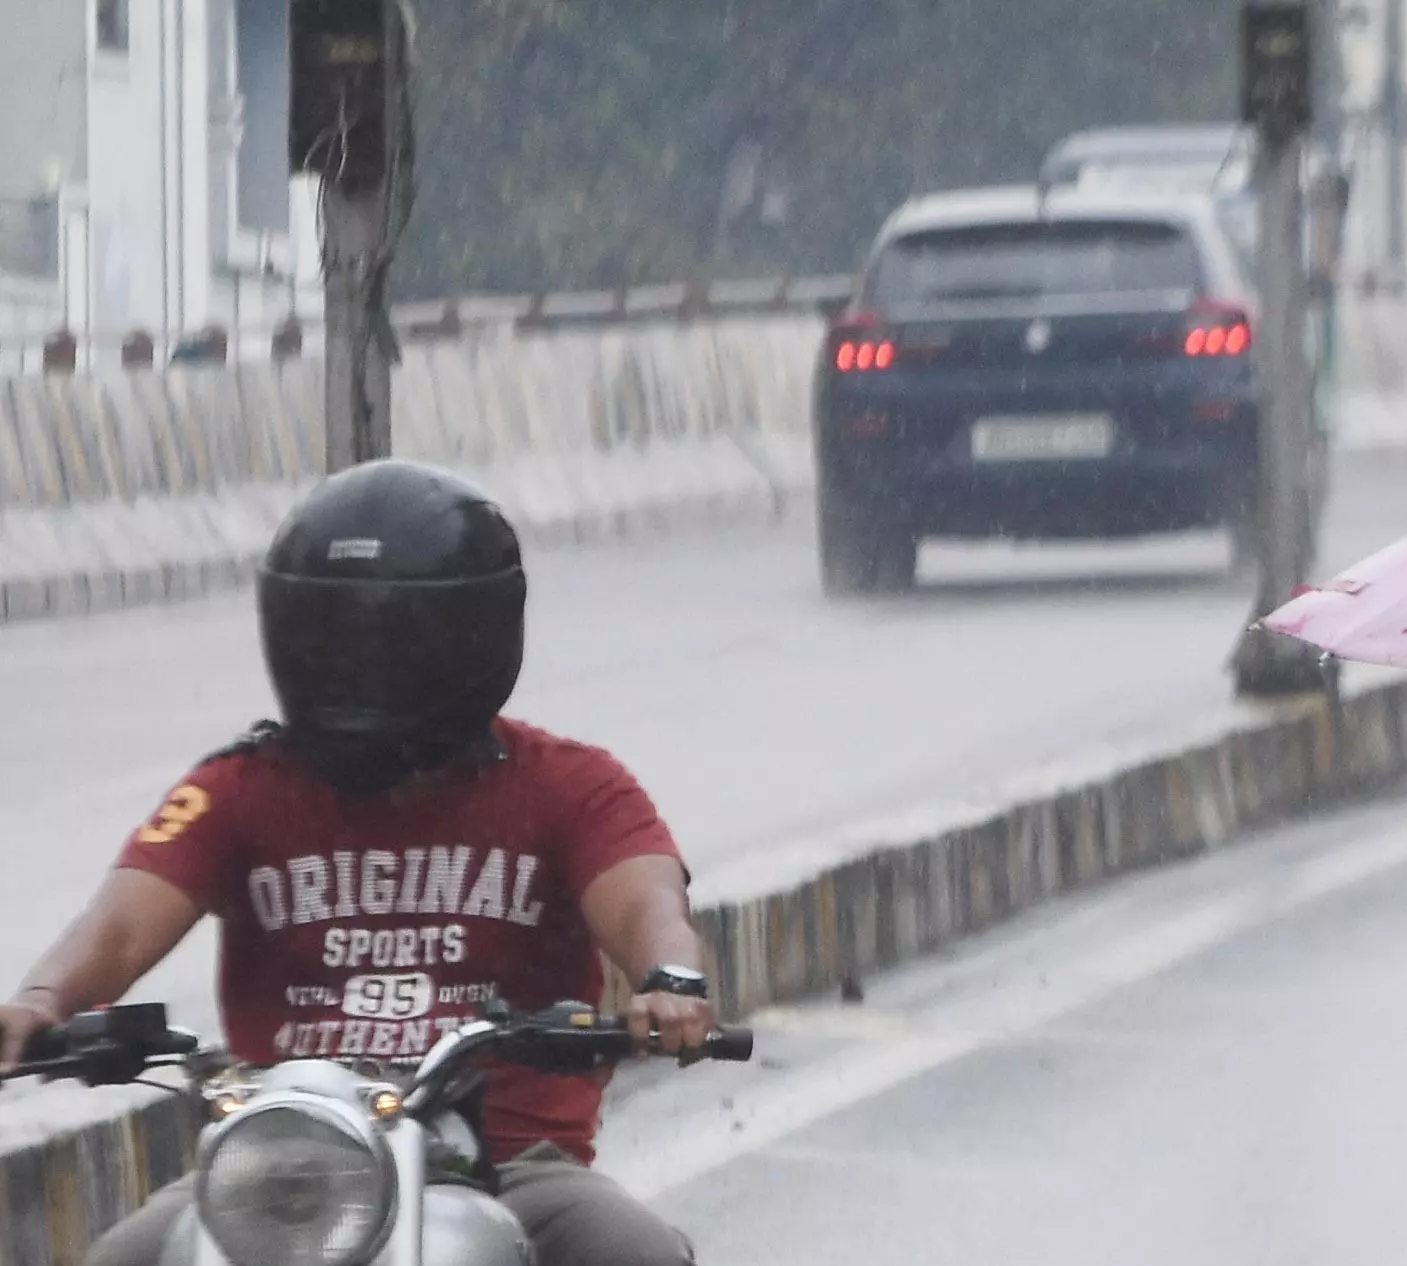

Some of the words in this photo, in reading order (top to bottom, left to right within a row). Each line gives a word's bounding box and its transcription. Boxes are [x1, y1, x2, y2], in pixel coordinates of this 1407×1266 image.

[249, 845, 545, 931] ORIGINAL
[322, 923, 467, 967] SPORTS
[357, 978, 418, 1016] 95
[274, 1015, 477, 1056] AUTHENT
